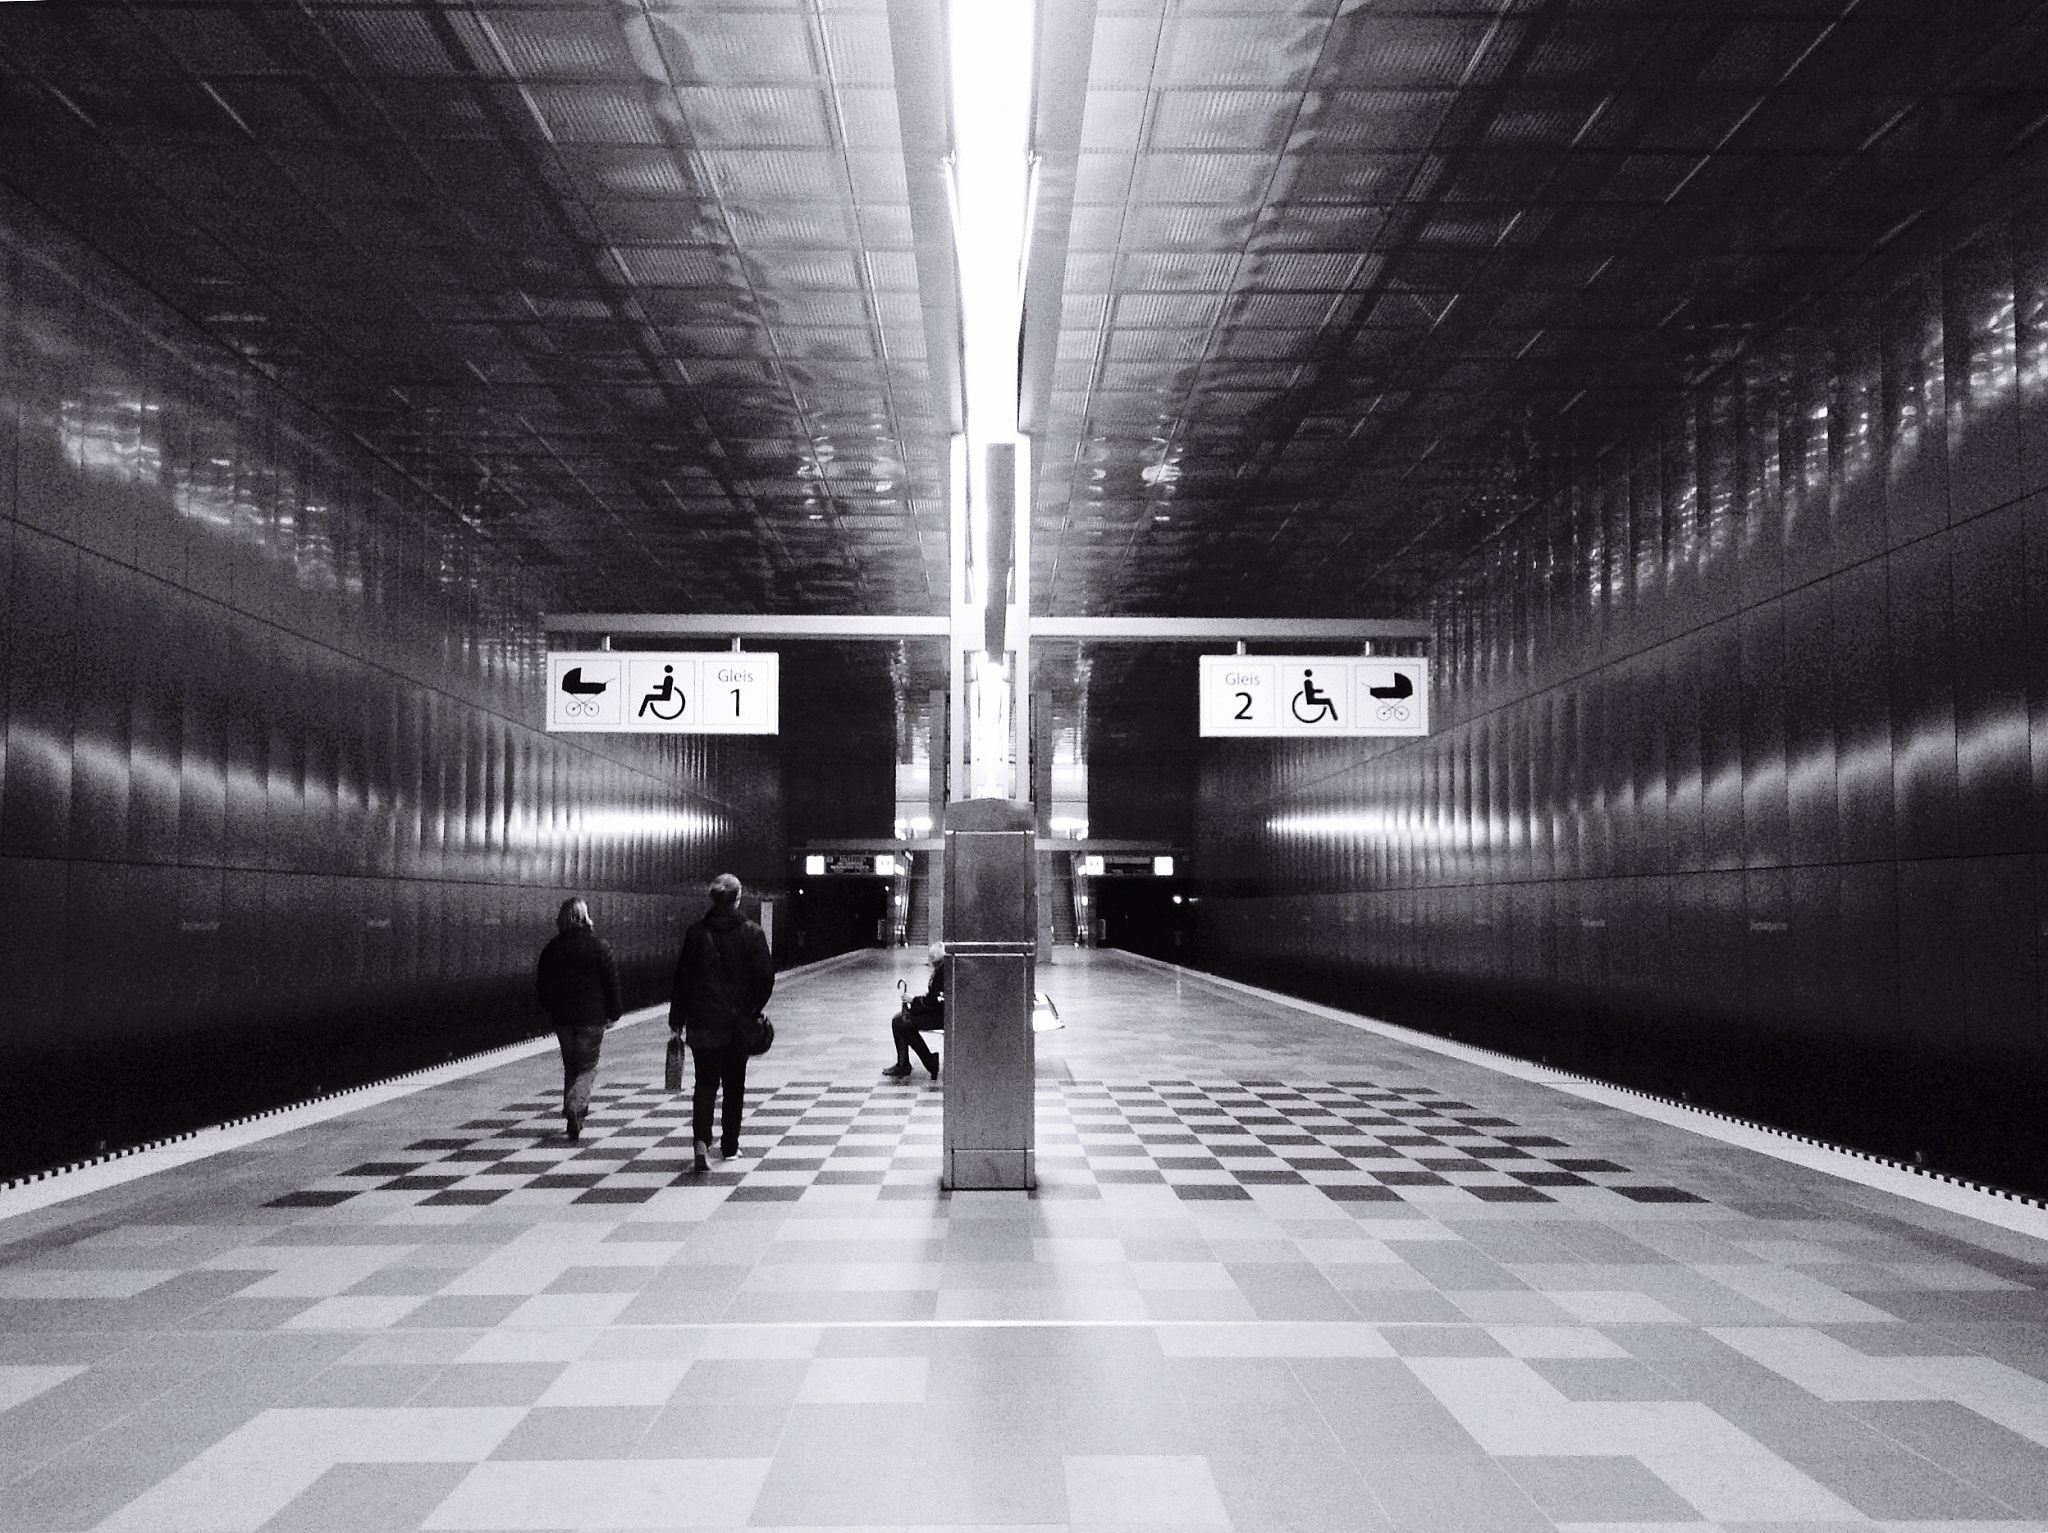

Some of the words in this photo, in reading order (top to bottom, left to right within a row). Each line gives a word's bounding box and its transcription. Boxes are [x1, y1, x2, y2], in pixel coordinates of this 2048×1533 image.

[717, 668, 754, 683] Gleis
[1225, 672, 1260, 686] Gleis
[730, 688, 740, 717] 1
[1234, 692, 1253, 720] 2
